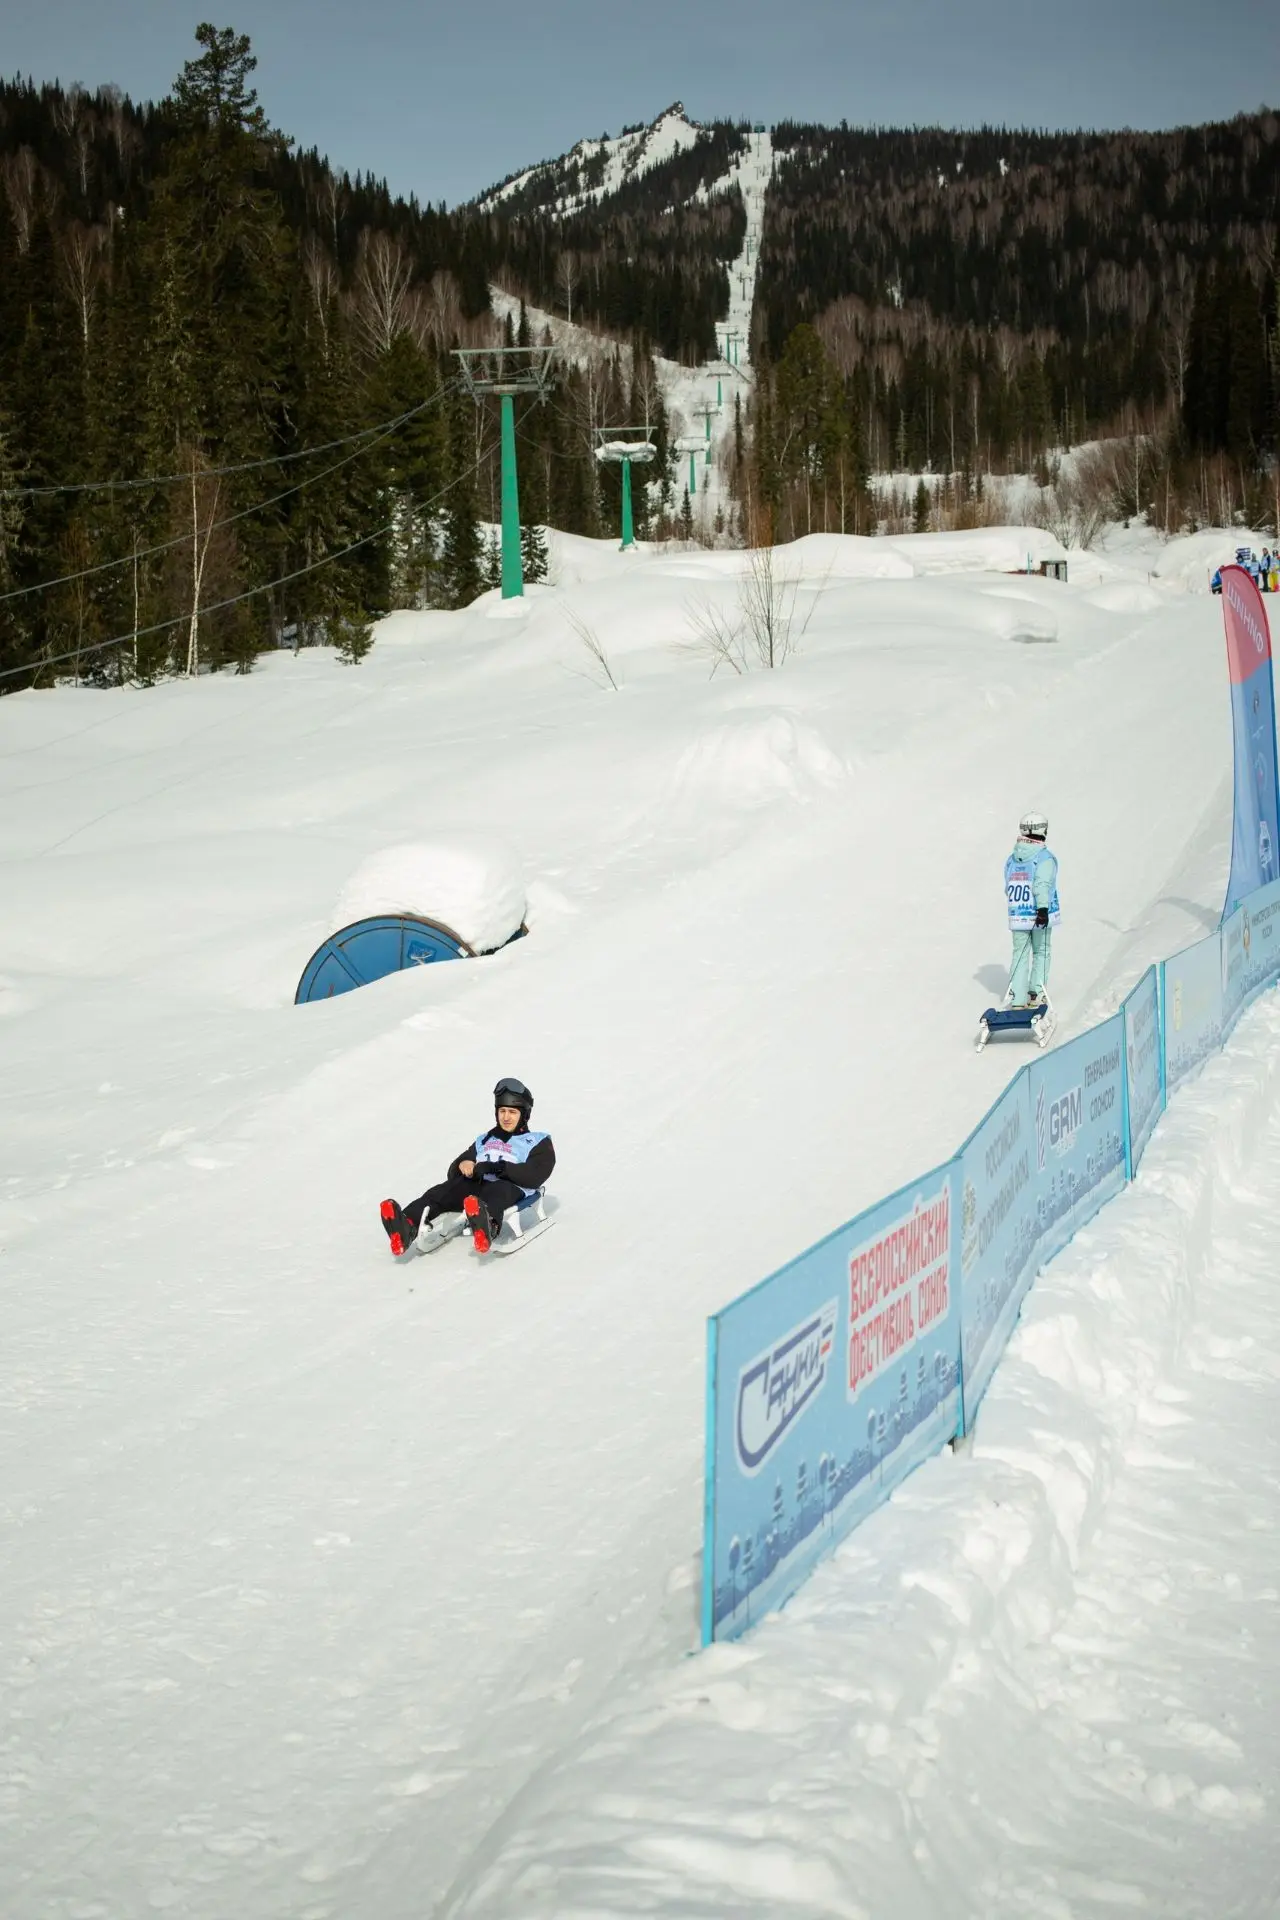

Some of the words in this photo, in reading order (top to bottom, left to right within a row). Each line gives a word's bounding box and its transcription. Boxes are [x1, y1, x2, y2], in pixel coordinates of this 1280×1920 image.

[1008, 884, 1030, 902] 206
[1084, 1043, 1119, 1088] ГЕНЕРАЛЬНЫЙ
[1090, 1085, 1115, 1122] СПОНСОР
[850, 1186, 949, 1324] ВСЕРОССИЙСКИЙ
[849, 1290, 914, 1392] ФЕСТИВАЛЬ
[918, 1262, 948, 1329] САНОК
